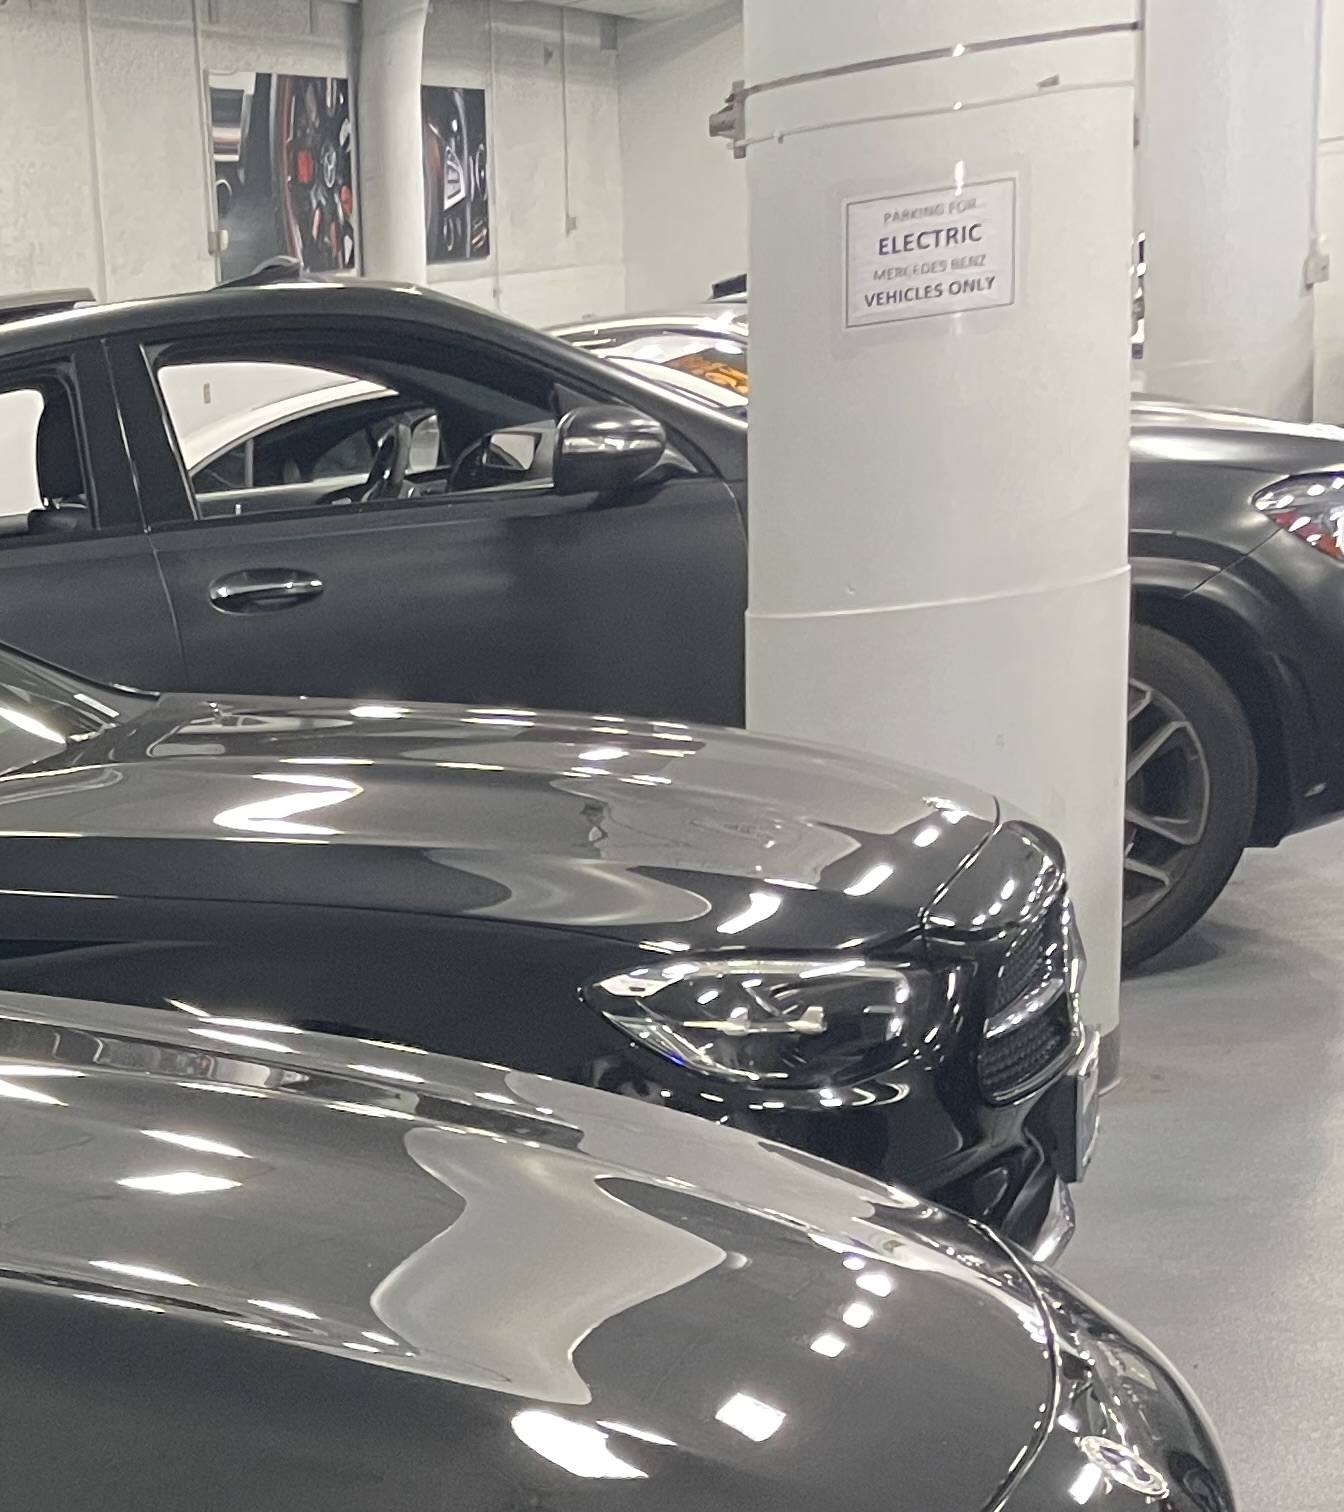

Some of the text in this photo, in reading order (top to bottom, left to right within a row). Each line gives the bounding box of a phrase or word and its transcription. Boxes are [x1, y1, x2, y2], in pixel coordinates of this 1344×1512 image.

[883, 197, 977, 225] PARKING FOR
[878, 223, 983, 256] ELECTRIC
[872, 254, 987, 281] MERCEDES BENZ
[864, 275, 996, 308] VEHICLES ONLY
